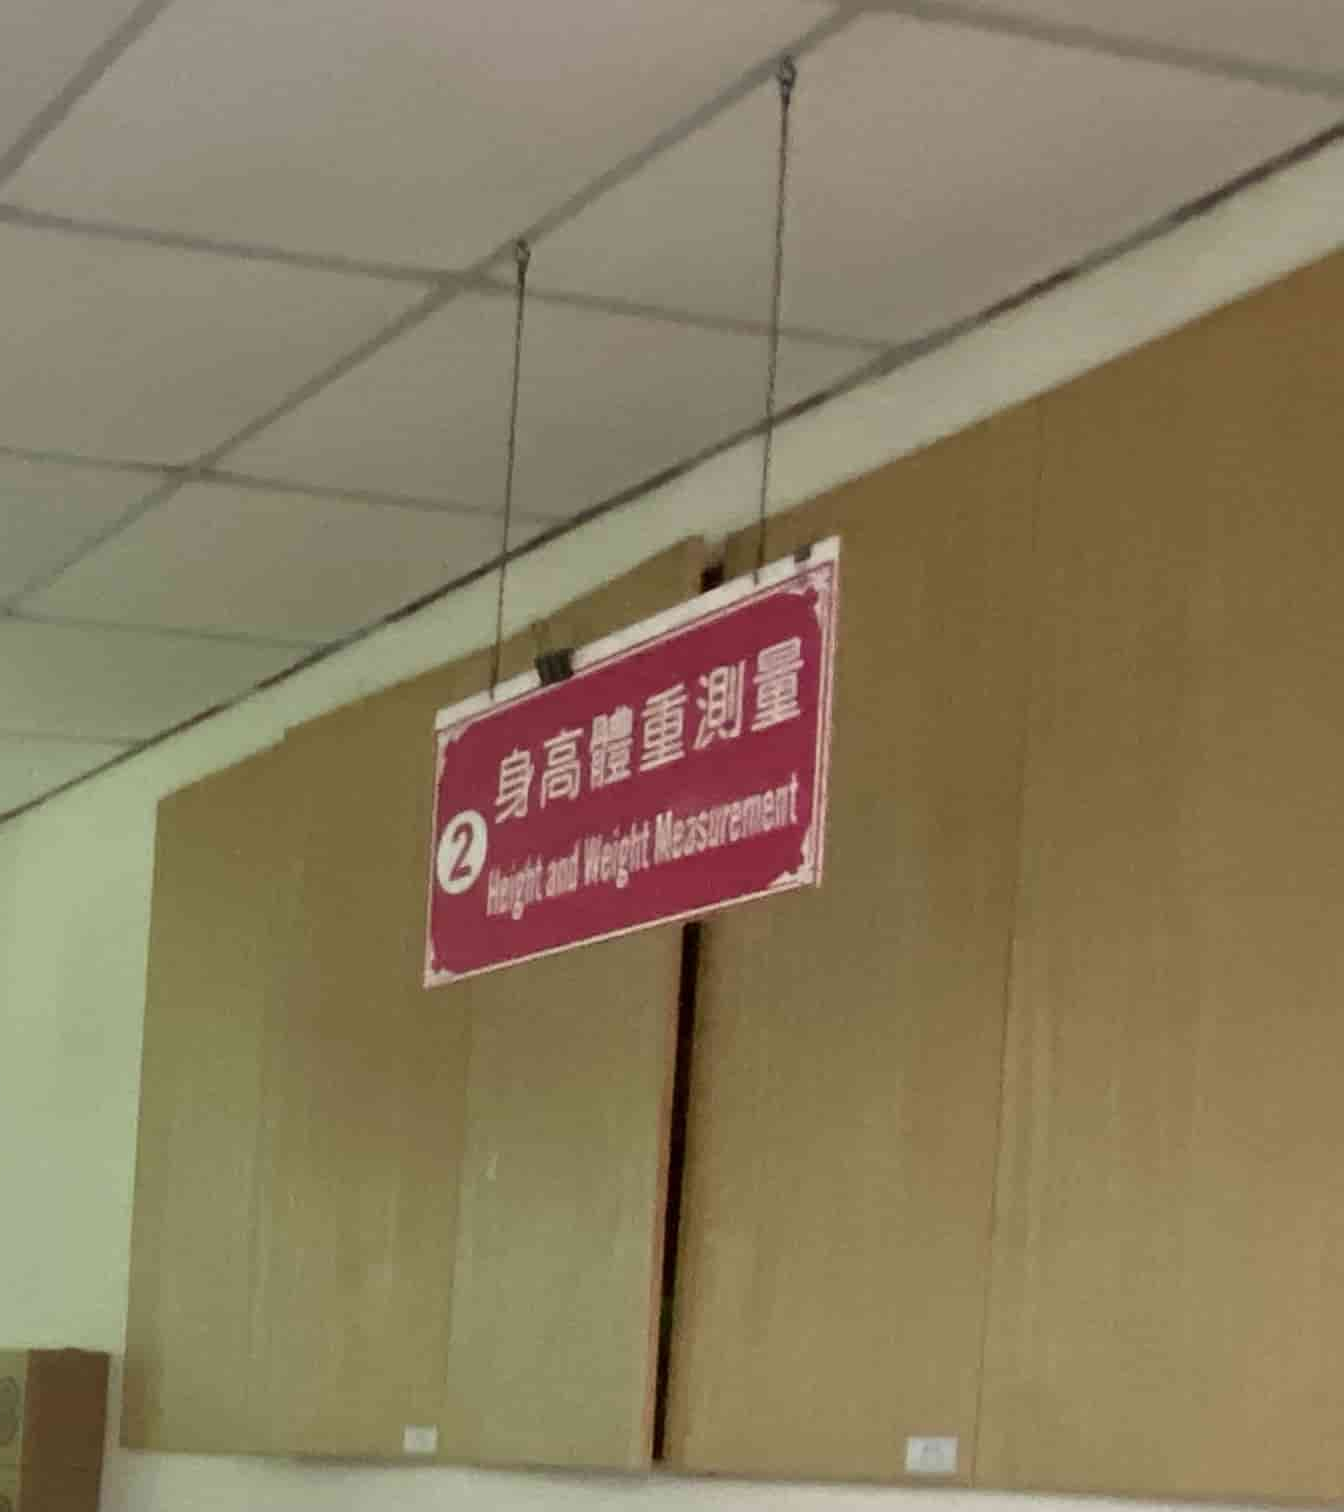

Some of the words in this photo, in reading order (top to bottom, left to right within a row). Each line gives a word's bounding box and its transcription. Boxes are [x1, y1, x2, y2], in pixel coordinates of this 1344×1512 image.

[494, 637, 805, 824] 身高體重測量
[448, 821, 474, 882] 2
[486, 853, 543, 920] Height
[544, 838, 580, 897] and
[583, 820, 650, 888] Weight
[654, 771, 798, 864] Measurement
